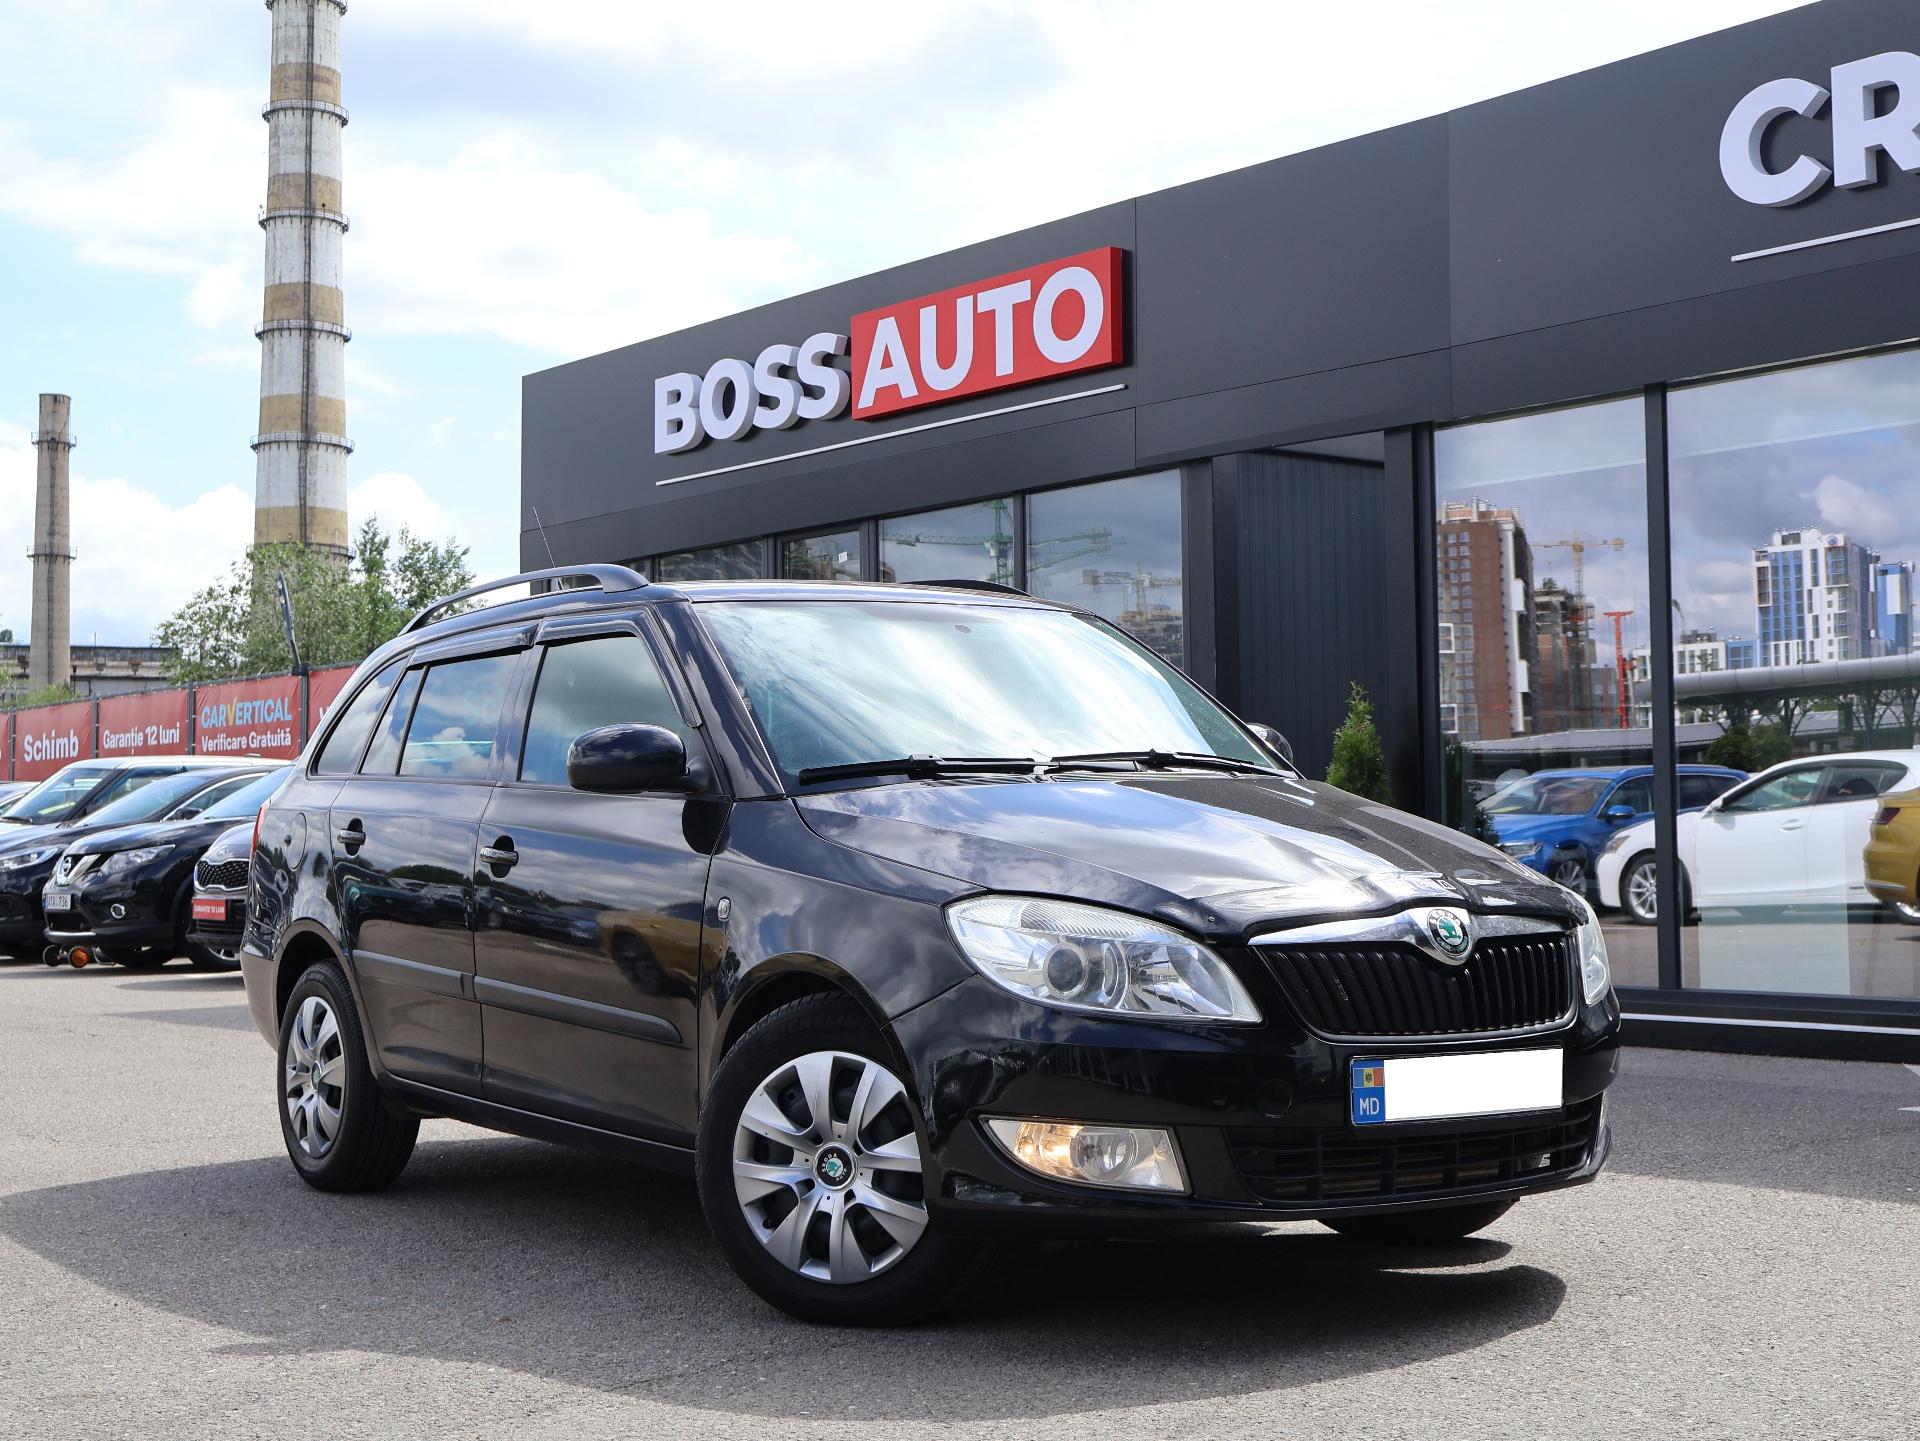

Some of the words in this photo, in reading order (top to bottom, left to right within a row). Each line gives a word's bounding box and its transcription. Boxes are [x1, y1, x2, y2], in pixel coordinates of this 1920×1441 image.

[201, 696, 293, 729] CARVERTICAL
[23, 729, 79, 762] Schimb
[145, 725, 158, 746] 12
[159, 721, 180, 745] luni
[201, 733, 249, 752] Verificare
[248, 727, 292, 748] Gratuită
[1359, 1097, 1380, 1116] MD
